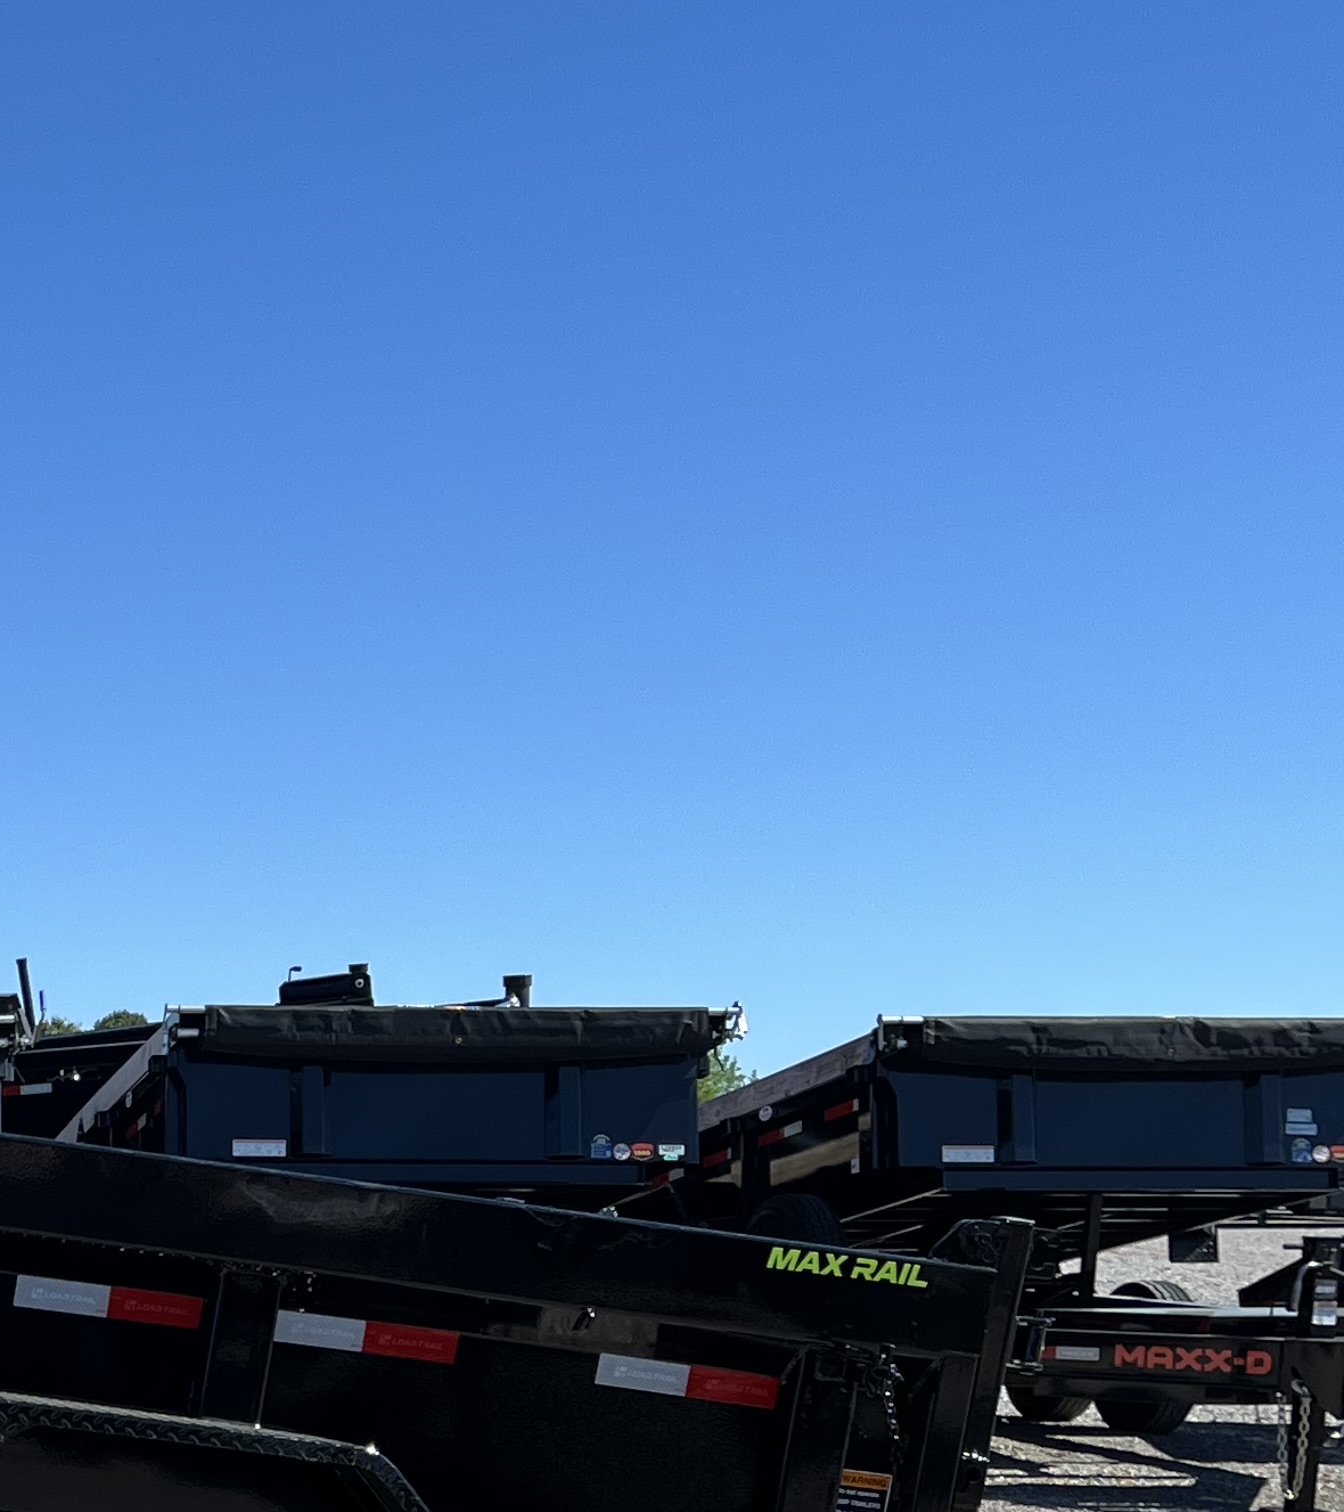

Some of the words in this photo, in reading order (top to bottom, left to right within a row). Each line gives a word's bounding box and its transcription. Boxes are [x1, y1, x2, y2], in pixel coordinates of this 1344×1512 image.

[766, 1246, 849, 1277] MAX
[850, 1257, 928, 1288] RAIL
[1114, 1343, 1273, 1375] MAXX-D
